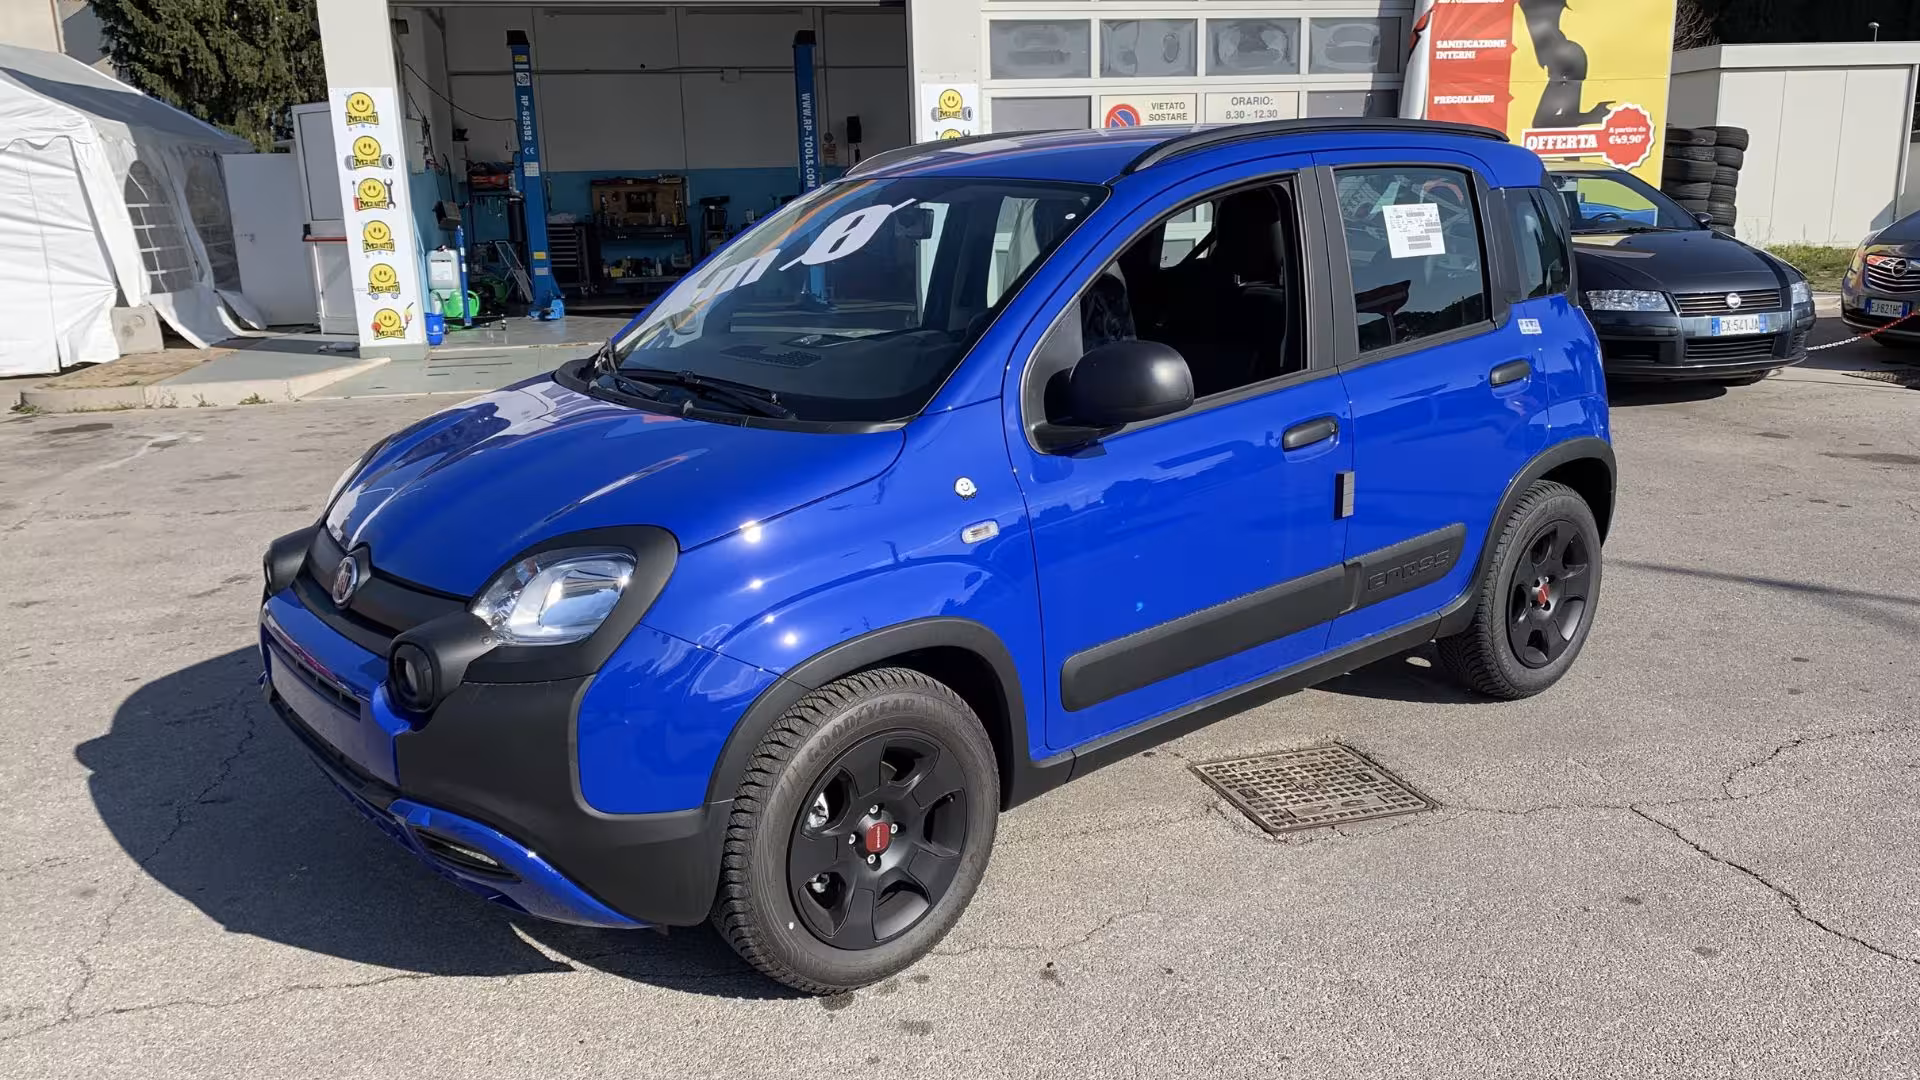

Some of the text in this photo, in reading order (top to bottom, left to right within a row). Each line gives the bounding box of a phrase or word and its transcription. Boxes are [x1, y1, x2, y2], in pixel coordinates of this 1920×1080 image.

[1436, 51, 1476, 60] INTERNI
[1231, 96, 1273, 106] ORARIO:
[1151, 102, 1186, 111] VIETATO
[1148, 113, 1188, 122] SOSTARE
[1225, 110, 1245, 120] 8.30
[1254, 110, 1278, 119] 12.30
[1526, 134, 1598, 151] OFFERTA
[1367, 548, 1450, 592] CROSS
